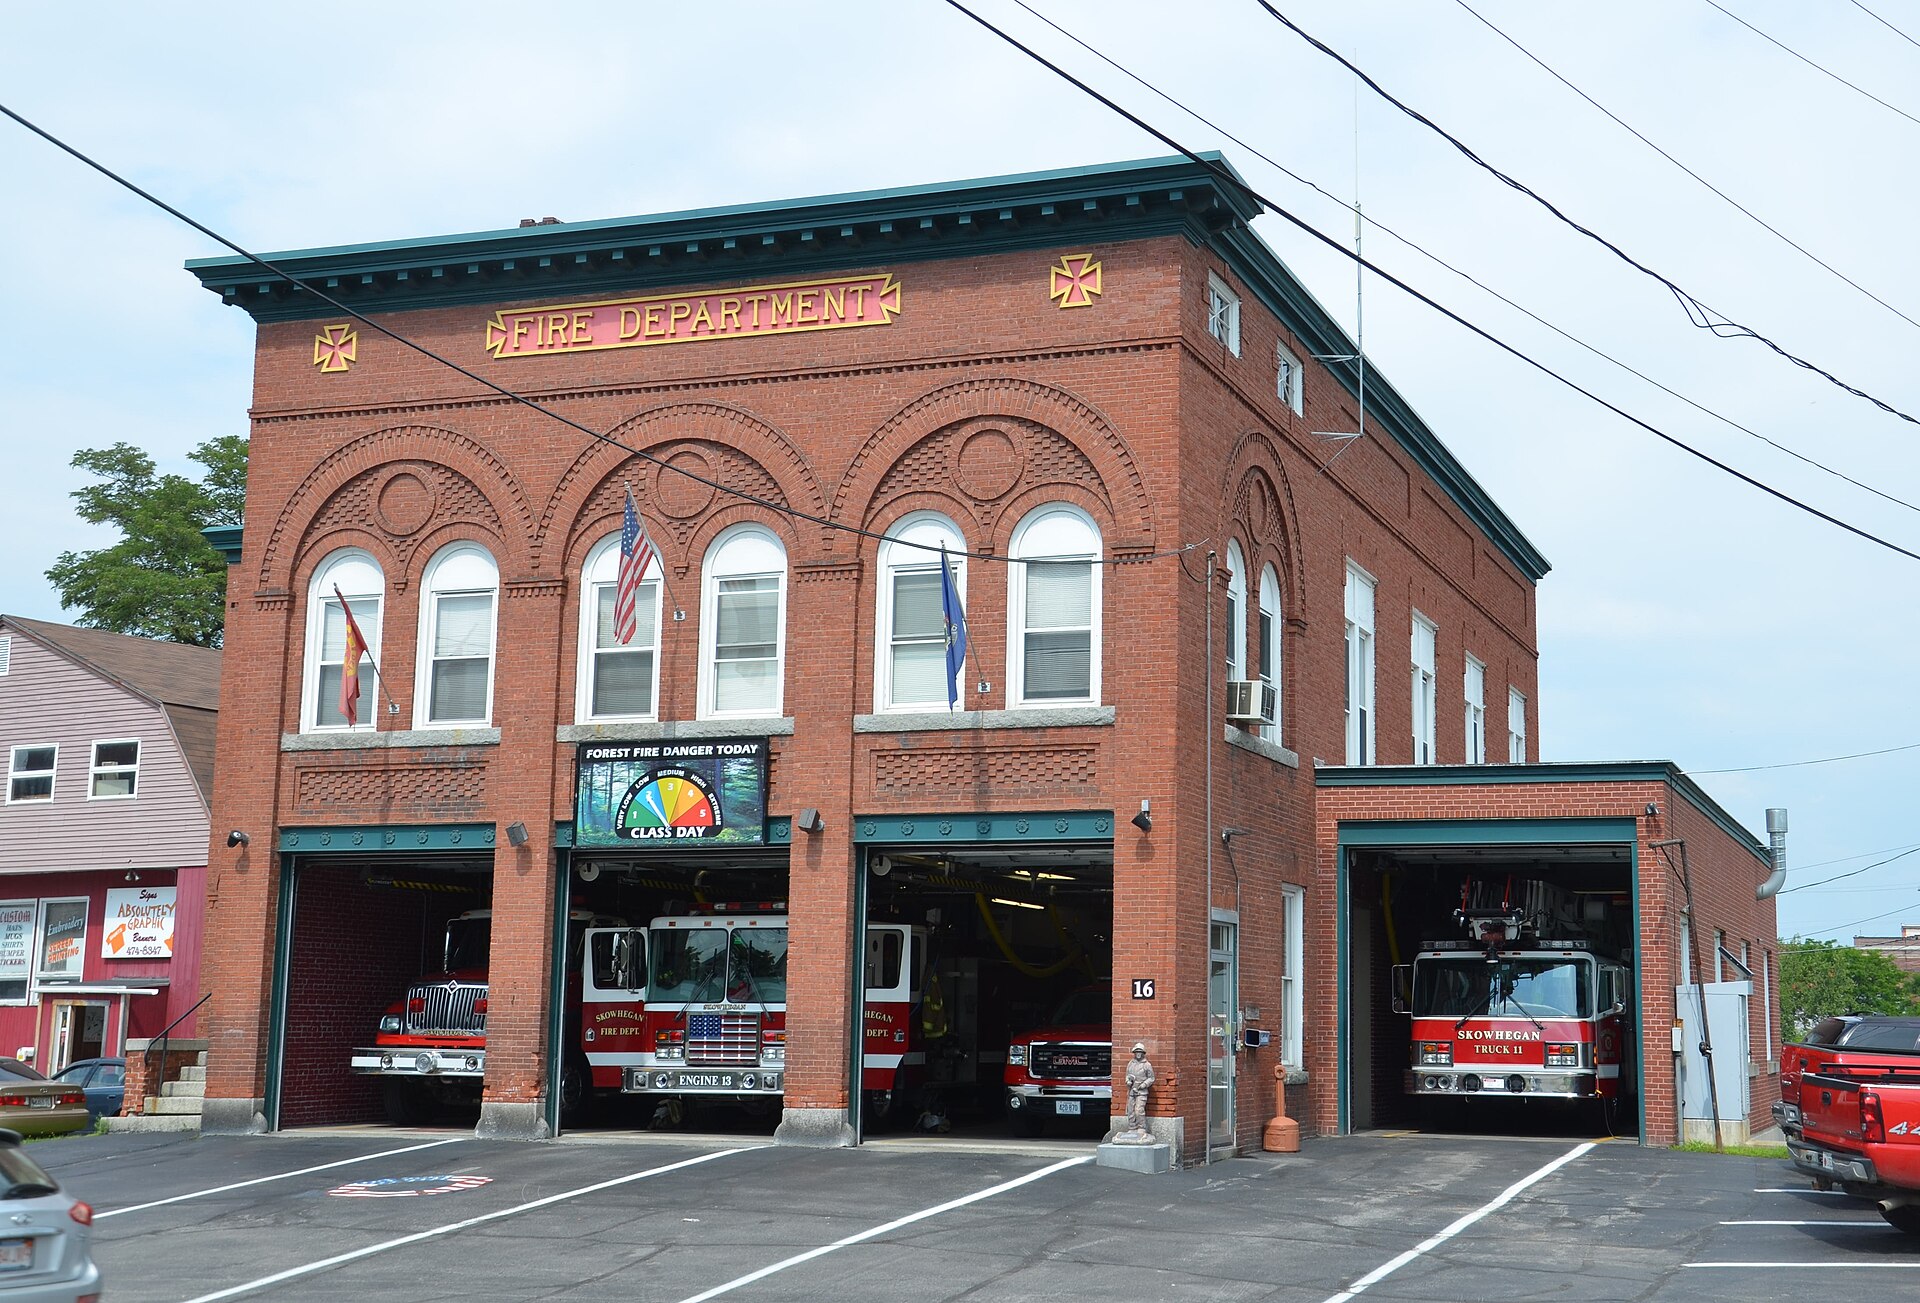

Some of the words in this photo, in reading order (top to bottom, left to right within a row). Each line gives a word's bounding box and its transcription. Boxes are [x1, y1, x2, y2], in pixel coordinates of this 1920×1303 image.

[512, 311, 595, 349] FIRE
[618, 284, 872, 339] DEPARTMENT
[586, 747, 631, 759] FOREST
[633, 747, 660, 757] FIRE
[662, 745, 713, 756] DANGER
[716, 744, 758, 755] TODAY
[657, 769, 685, 777] MEDIUM
[634, 775, 650, 789] LOW
[667, 782, 674, 791] 3
[690, 773, 707, 789] HIGH
[687, 789, 694, 797] 4
[616, 811, 625, 830] VERY
[621, 792, 633, 810] LOW
[632, 810, 638, 819] 1
[699, 809, 706, 818] 5
[707, 792, 722, 826] EXTREME
[630, 826, 672, 839] CLASS
[676, 826, 707, 838] DAY
[139, 889, 157, 902] Signs
[117, 900, 177, 918] ABSOLUTELY
[47, 915, 84, 937] Embroidery
[4, 932, 23, 940] MUGS
[132, 932, 157, 943] Banners
[48, 937, 74, 953] SCREEN
[47, 946, 79, 964] PRINTING
[1133, 980, 1154, 998] 16
[595, 1010, 645, 1023] SKOWHEGAN
[600, 1027, 618, 1036] FIRE
[619, 1027, 640, 1036] DEPT.
[866, 1028, 889, 1037] DEPT.
[1457, 1030, 1540, 1041] SKOWHEGAN
[1474, 1044, 1511, 1054] TRUCK
[1513, 1045, 1523, 1055] 11
[1053, 1055, 1088, 1066] GMC
[679, 1075, 719, 1086] ENGINE
[721, 1075, 732, 1086] 13
